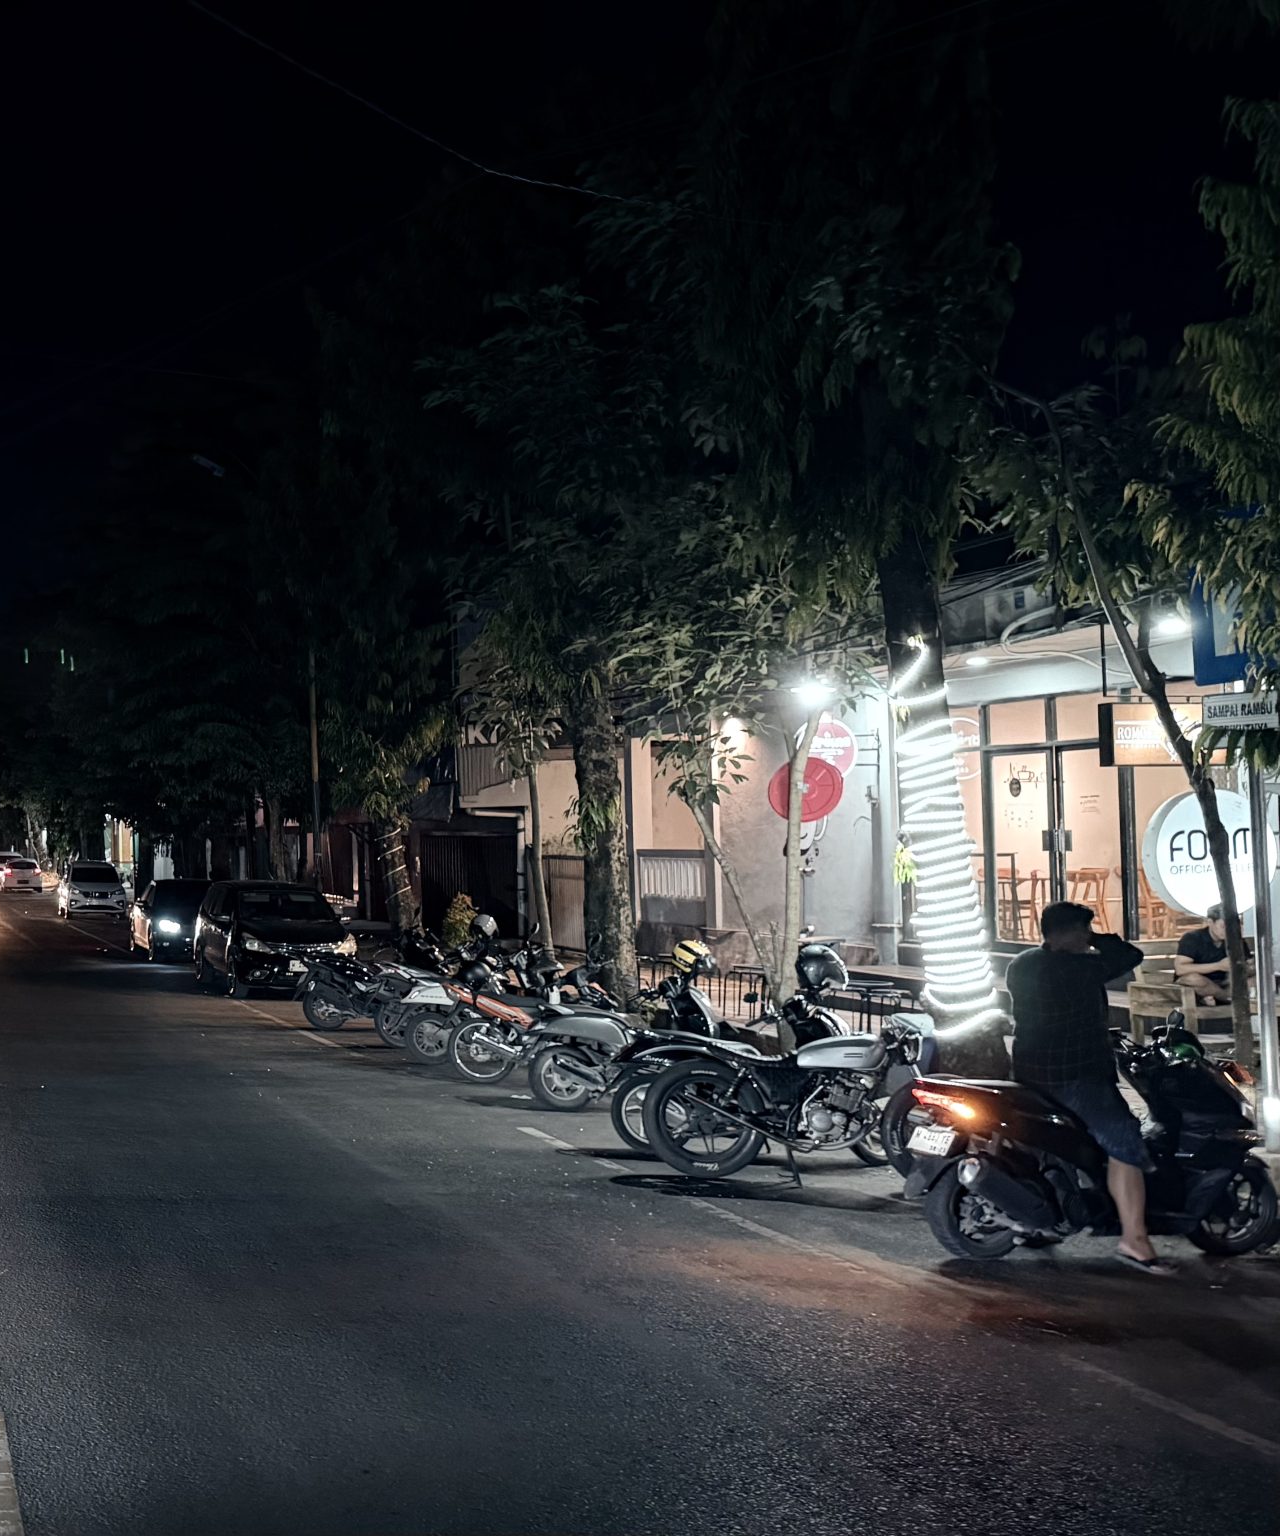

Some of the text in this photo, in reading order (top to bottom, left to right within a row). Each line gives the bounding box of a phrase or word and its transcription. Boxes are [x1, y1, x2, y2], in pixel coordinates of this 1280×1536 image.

[1207, 702, 1272, 718] SAMPAI RAMBU
[1169, 828, 1250, 862] FOM
[1169, 864, 1213, 875] OFFICIA
